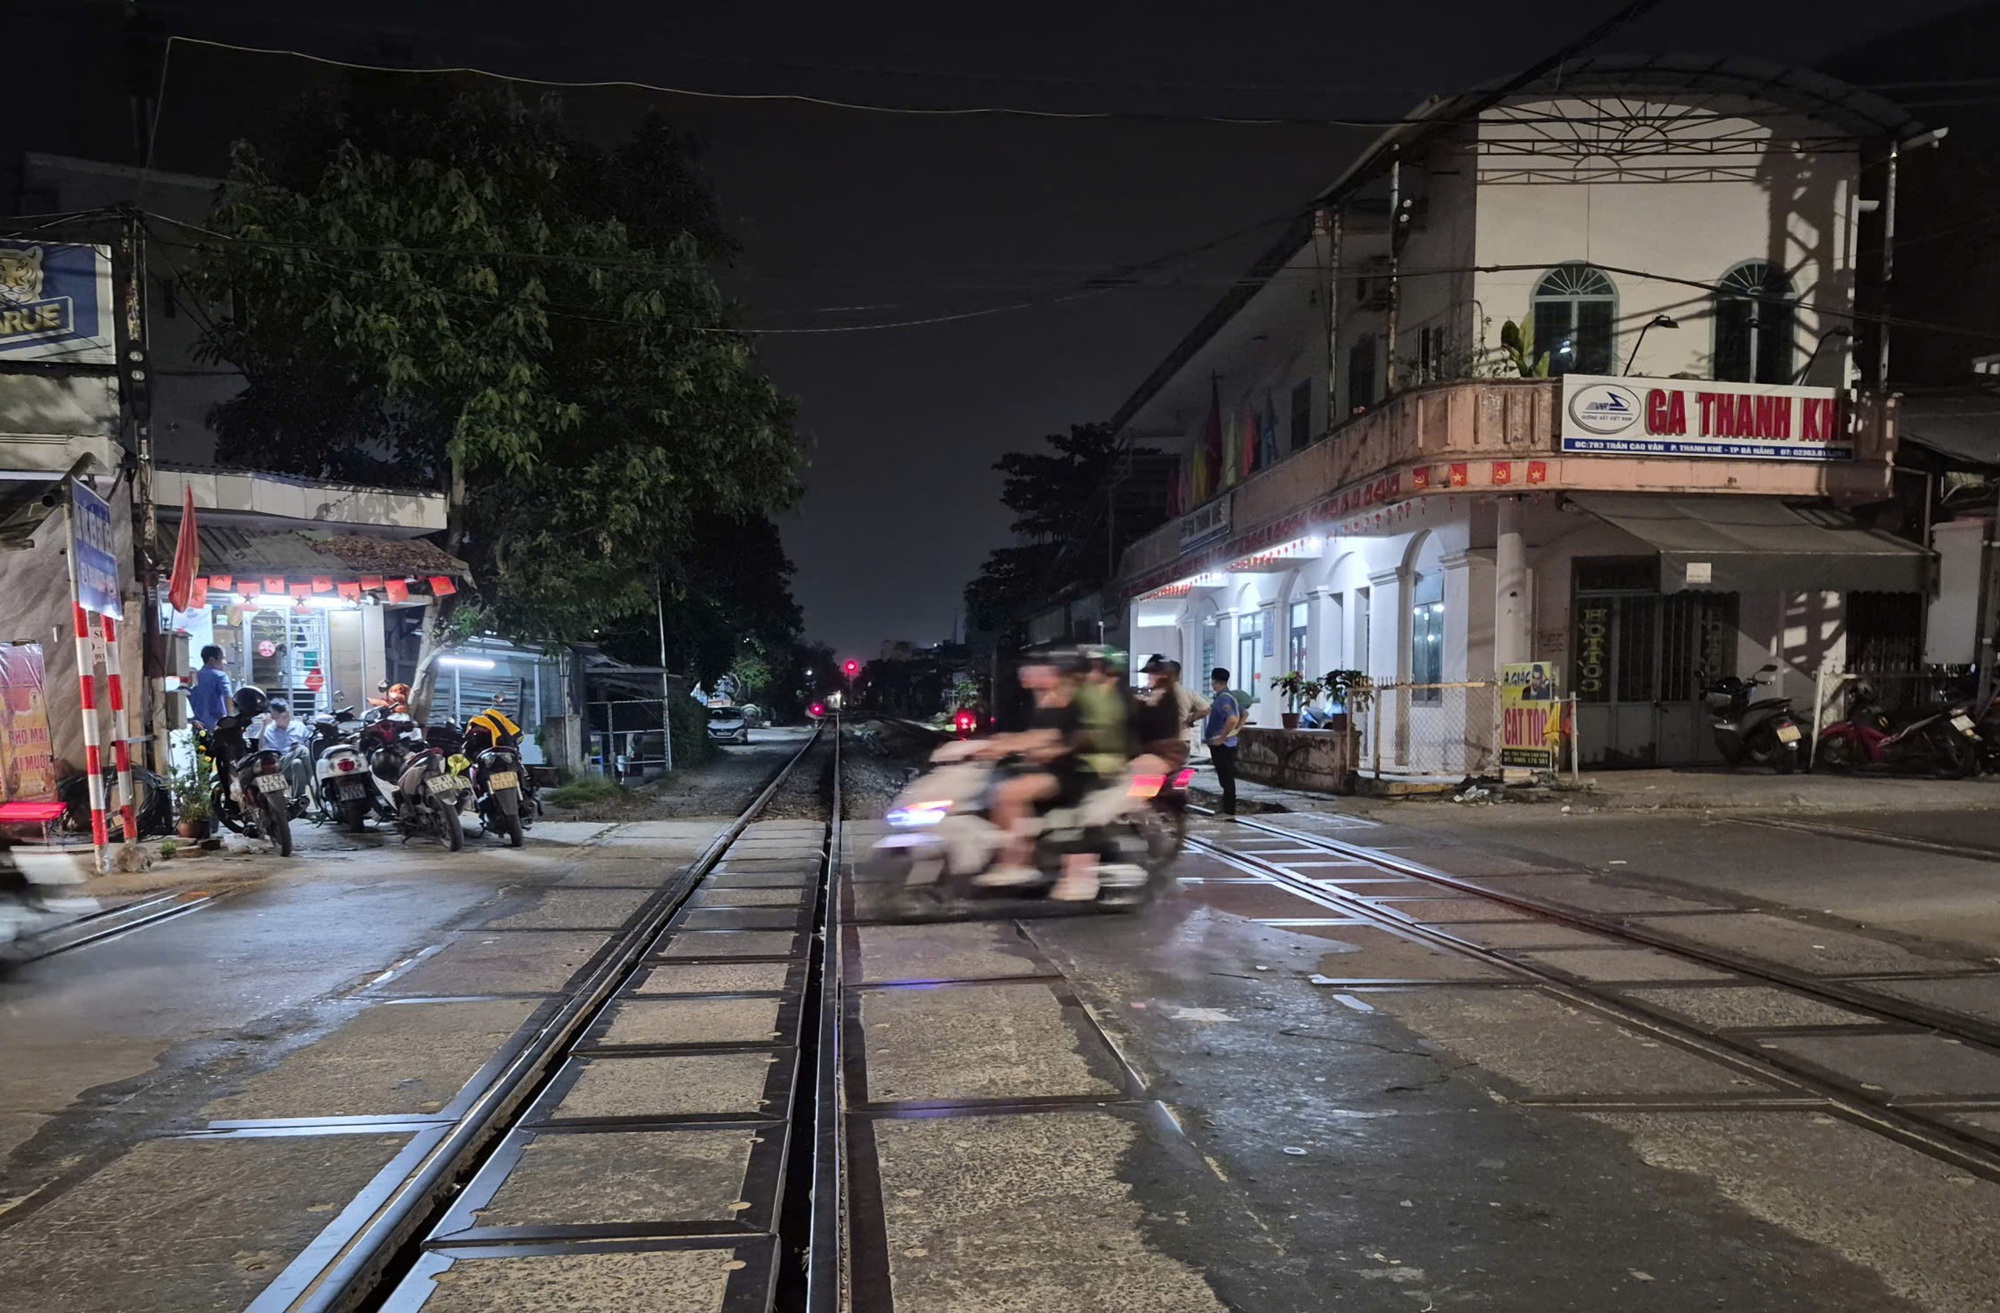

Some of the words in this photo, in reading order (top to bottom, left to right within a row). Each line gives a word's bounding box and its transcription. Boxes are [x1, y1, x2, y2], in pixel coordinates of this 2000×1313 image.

[0, 303, 61, 335] RUE
[1647, 388, 1687, 436] GA
[1697, 391, 1791, 440] THANH
[1629, 442, 1646, 450] CAO
[1648, 442, 1664, 451] VÂN
[1679, 445, 1706, 453] THANH
